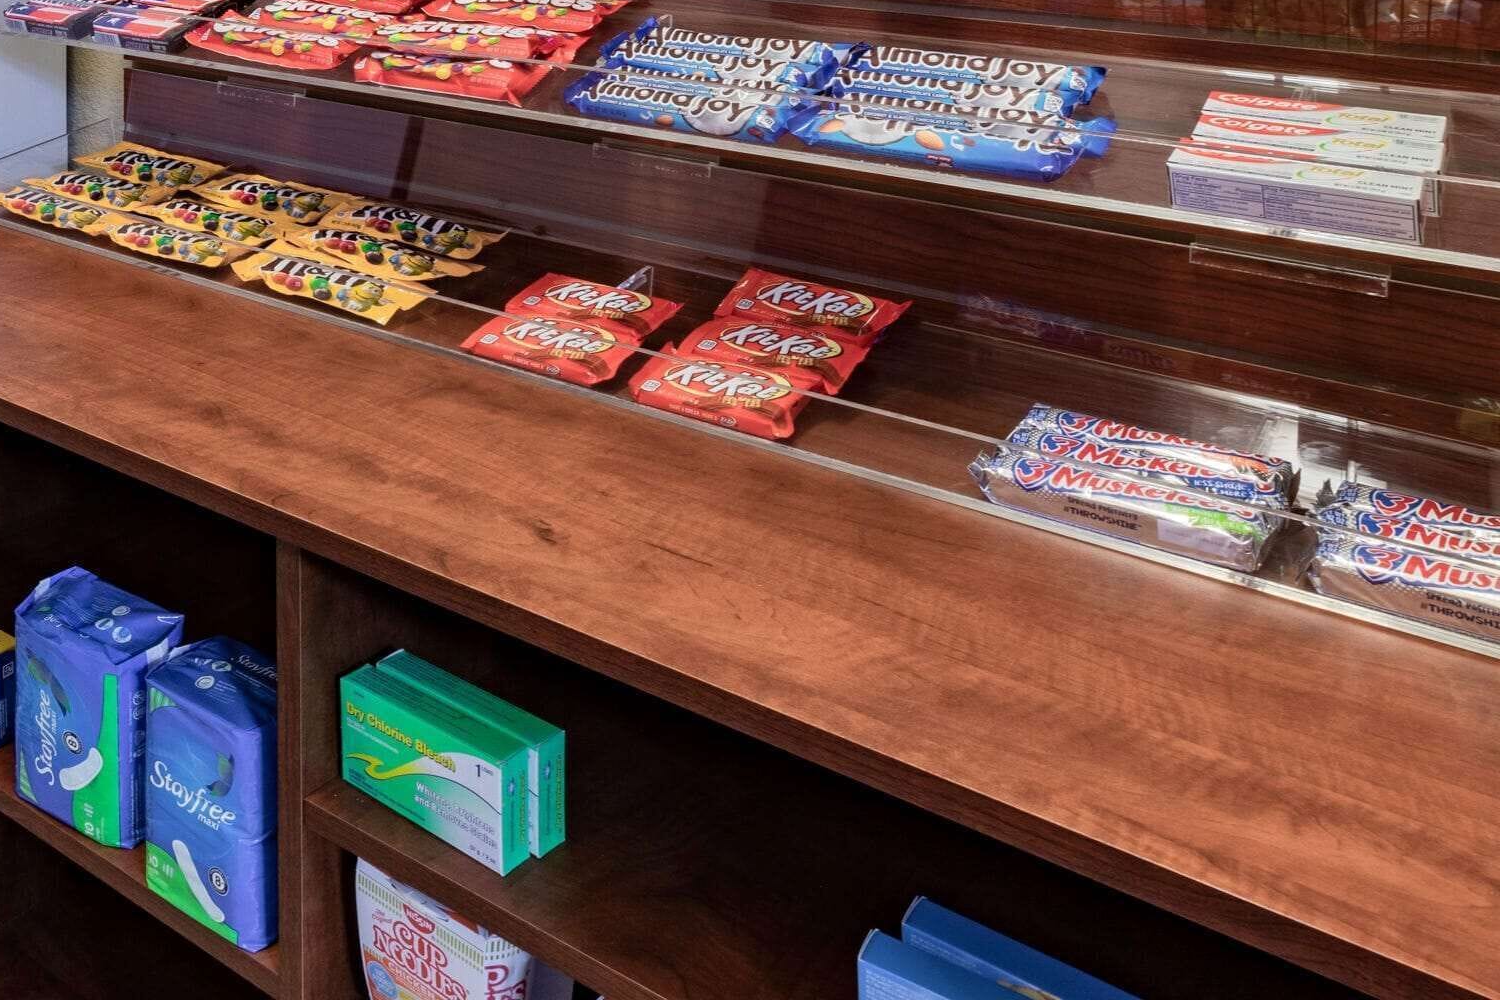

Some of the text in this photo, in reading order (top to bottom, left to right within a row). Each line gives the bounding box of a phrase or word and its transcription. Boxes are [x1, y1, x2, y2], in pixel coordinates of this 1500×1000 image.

[644, 26, 813, 60] Almond Joy
[854, 47, 1060, 87] Almond Joy
[589, 81, 758, 122] Almond Joy
[1217, 91, 1319, 111] Colgate
[1209, 116, 1312, 135] Colgate
[1014, 460, 1050, 485] 3
[35, 689, 58, 786] Stayfree
[346, 701, 457, 773] Dry Chlorine Bleach
[150, 760, 237, 826] Stayfree
[197, 813, 221, 831] maxi
[373, 924, 468, 1000] NOODLES
[393, 920, 448, 968] CUP
